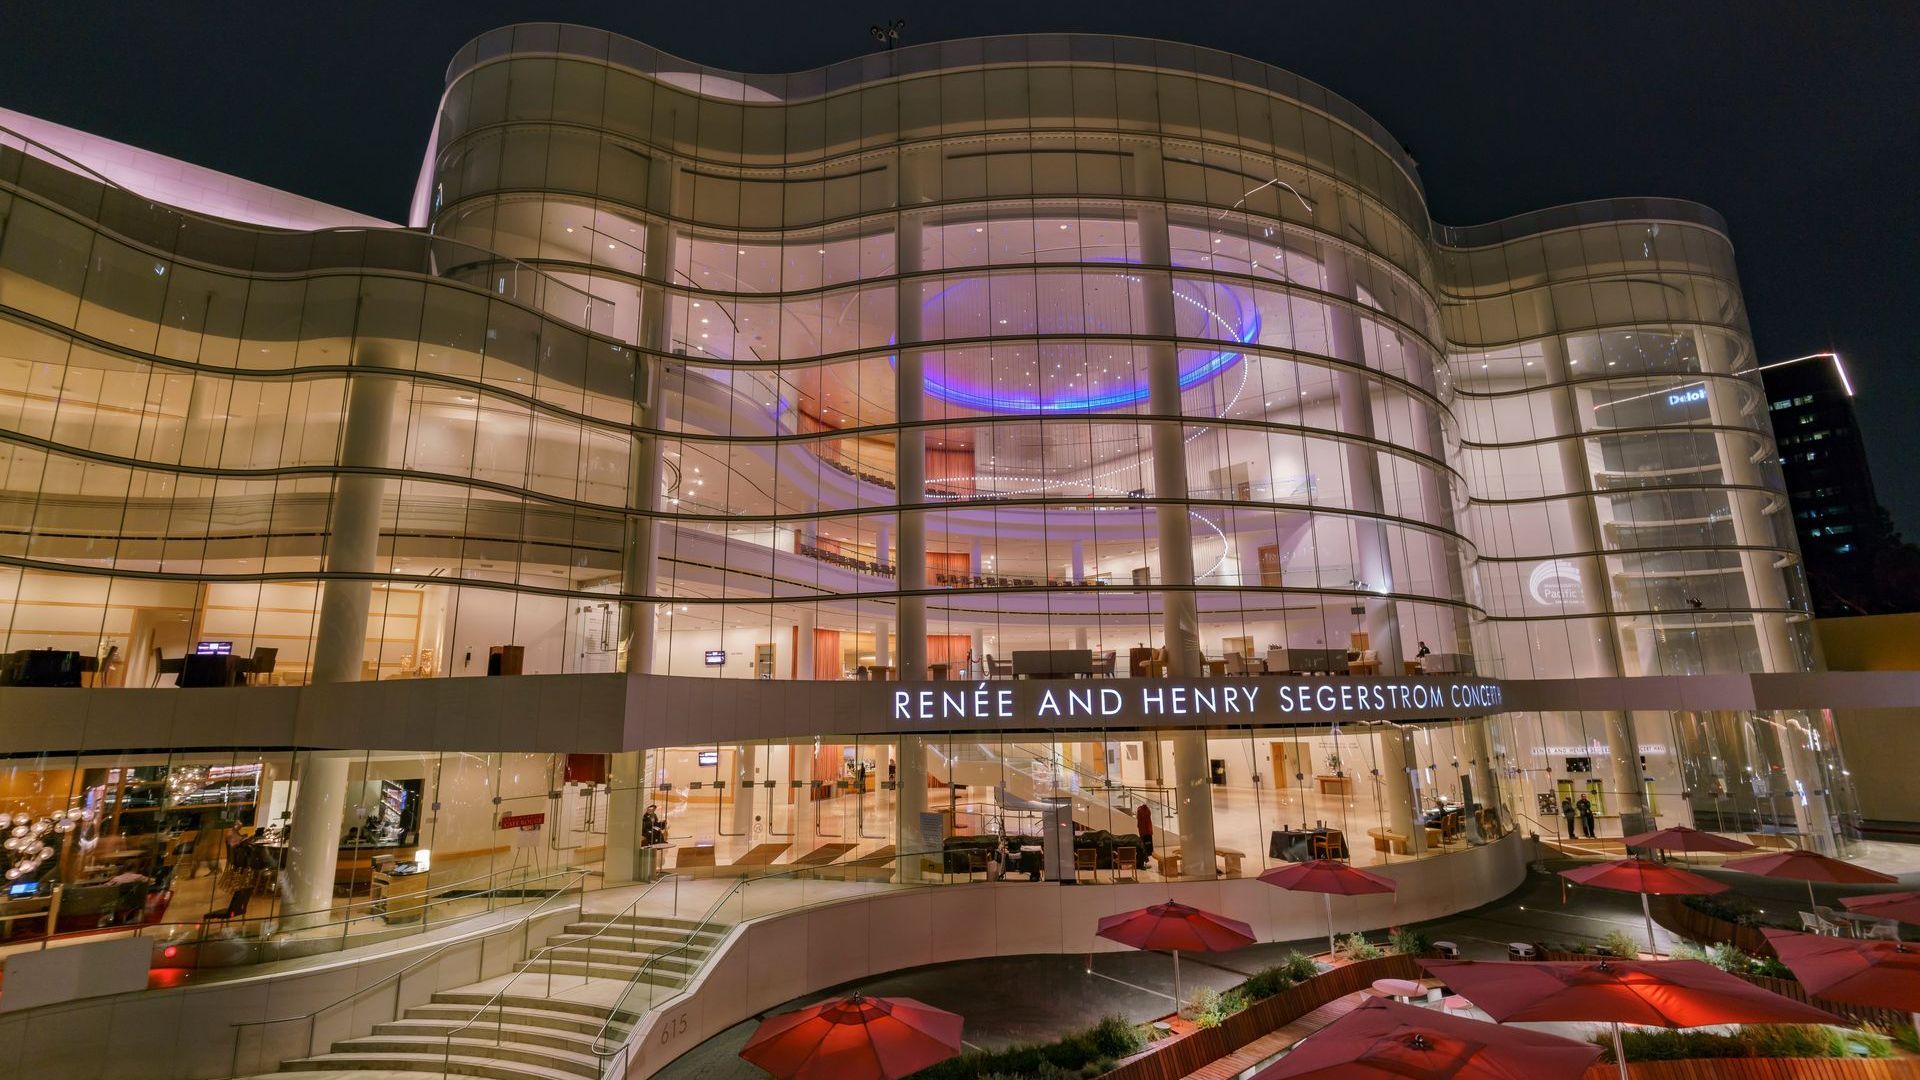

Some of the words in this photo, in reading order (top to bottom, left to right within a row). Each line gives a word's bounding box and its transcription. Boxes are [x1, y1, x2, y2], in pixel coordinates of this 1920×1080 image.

[1544, 588, 1577, 598] Pacific
[895, 682, 1013, 718] RENÉE
[1038, 688, 1123, 716] AND
[1143, 686, 1259, 714] HENRY
[1279, 684, 1444, 712] SEGERSTROM
[661, 1013, 688, 1044] 615
